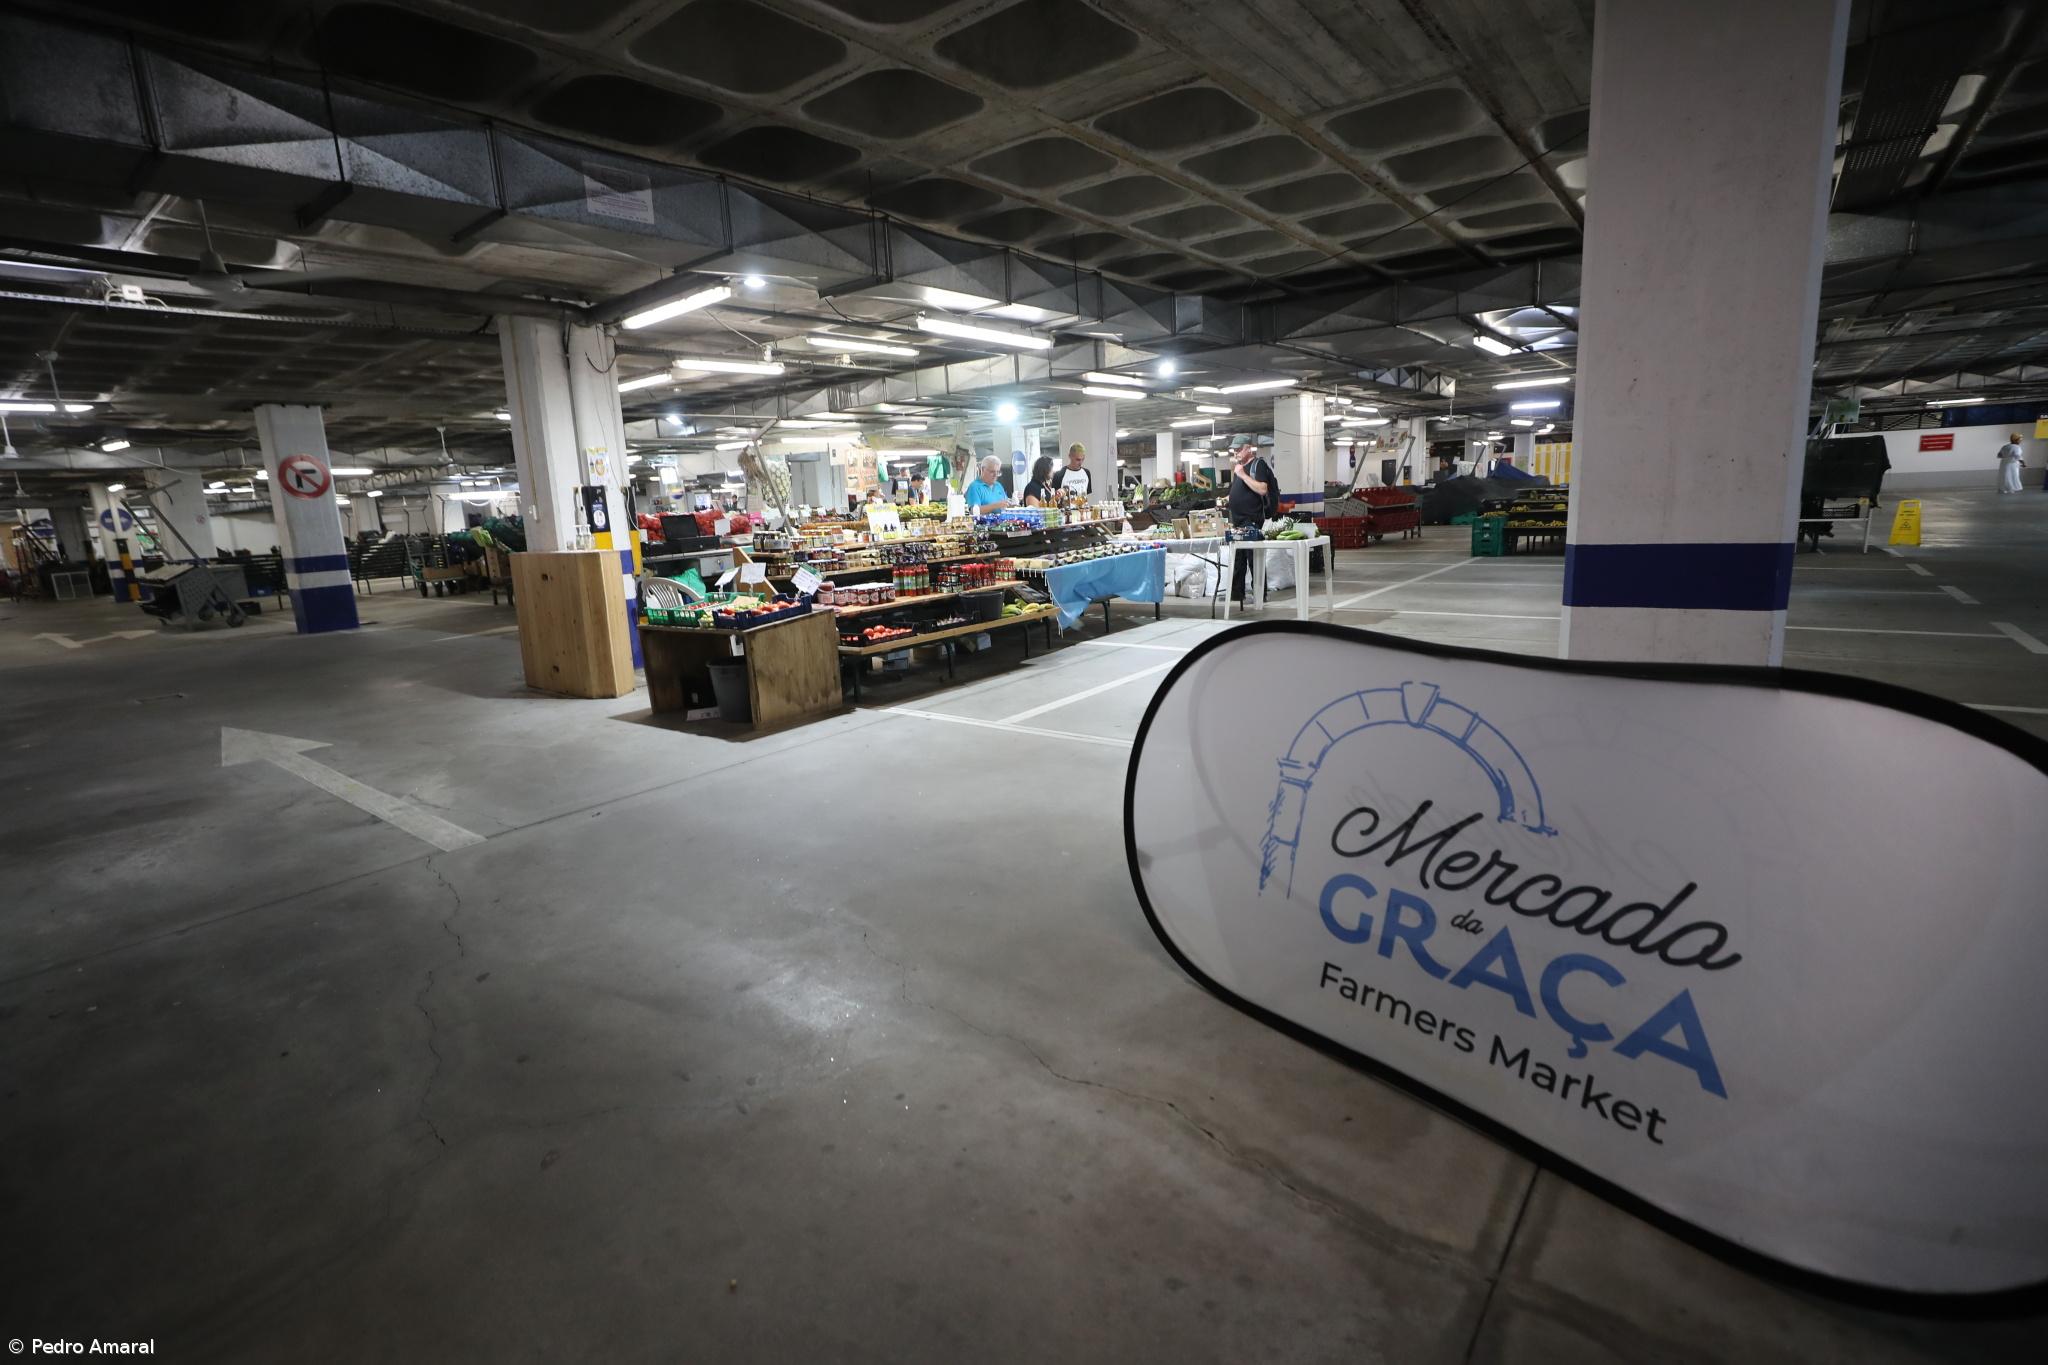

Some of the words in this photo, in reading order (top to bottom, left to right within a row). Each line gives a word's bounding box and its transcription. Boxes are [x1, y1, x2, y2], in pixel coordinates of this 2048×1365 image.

[1331, 800, 1742, 970] Mercado
[1451, 909, 1483, 935] da
[1319, 873, 1728, 1099] GRAÇA
[1320, 961, 1475, 1053] Farmers
[1489, 1035, 1667, 1145] Market
